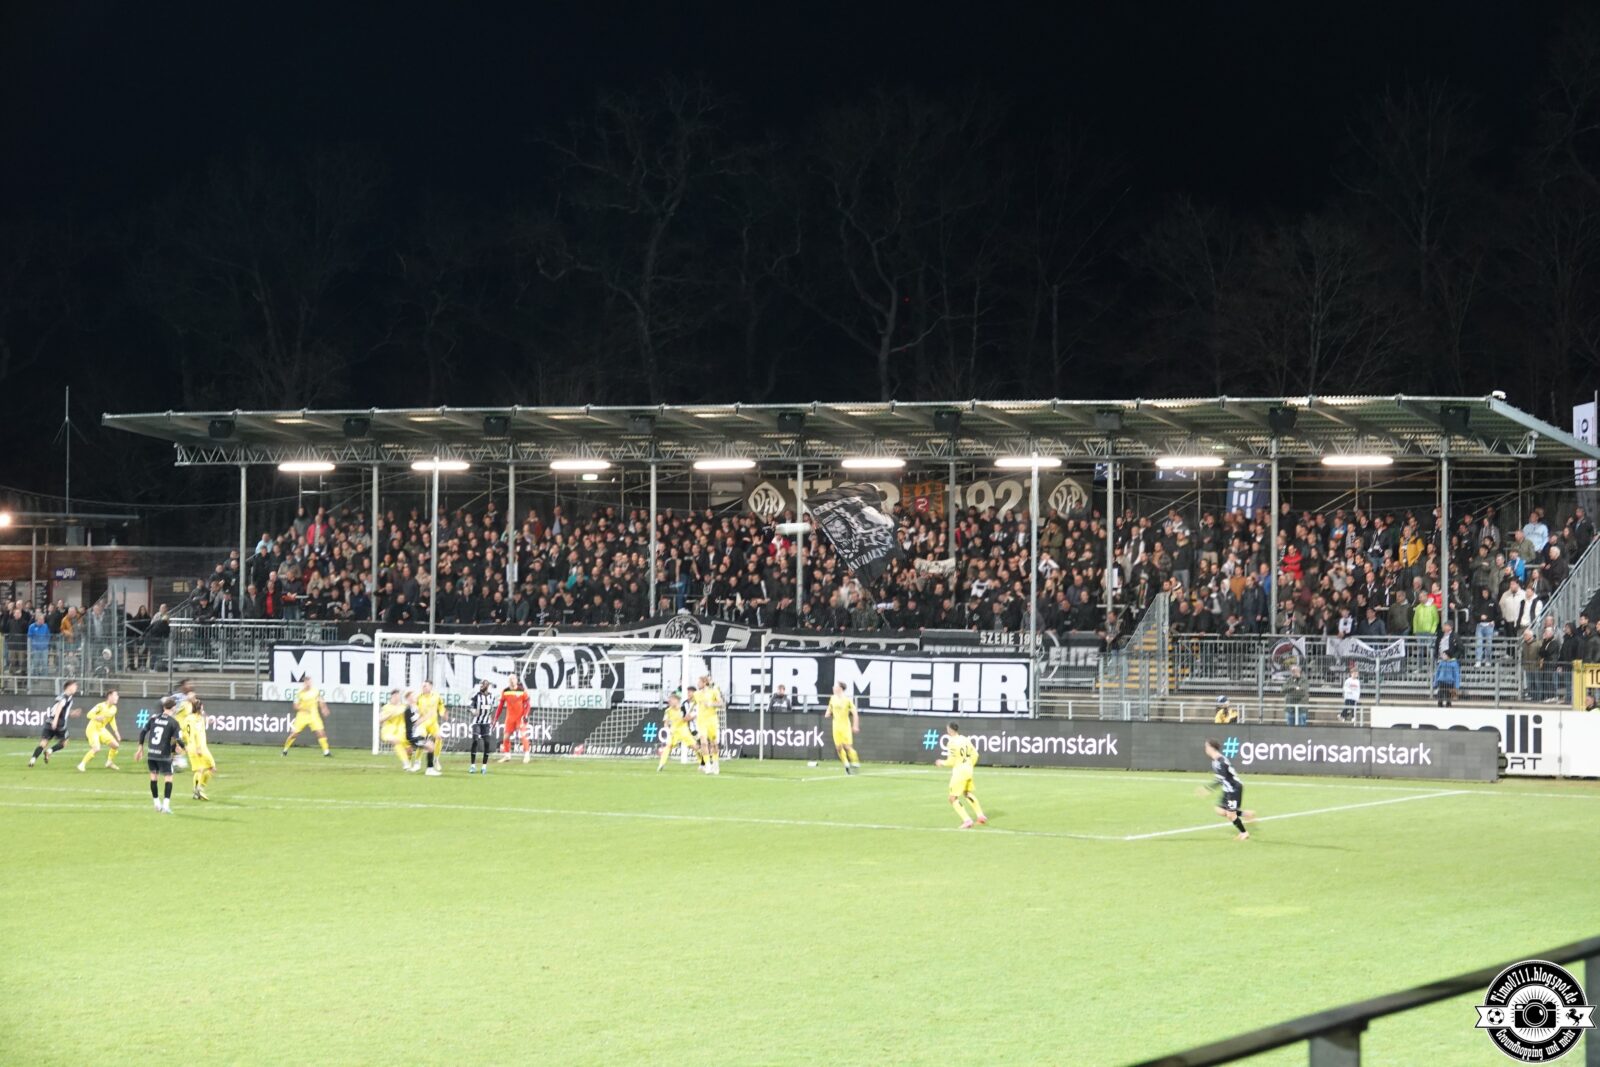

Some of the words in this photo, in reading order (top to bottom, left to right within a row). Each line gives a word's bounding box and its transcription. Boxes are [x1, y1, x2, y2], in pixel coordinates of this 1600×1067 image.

[980, 630, 1014, 645] SZENE
[274, 651, 377, 687] MIT
[834, 658, 1028, 712] MEHR
[558, 694, 603, 707] GEIGER
[151, 726, 164, 745] 3
[1222, 737, 1432, 765] #gemeinsamstark
